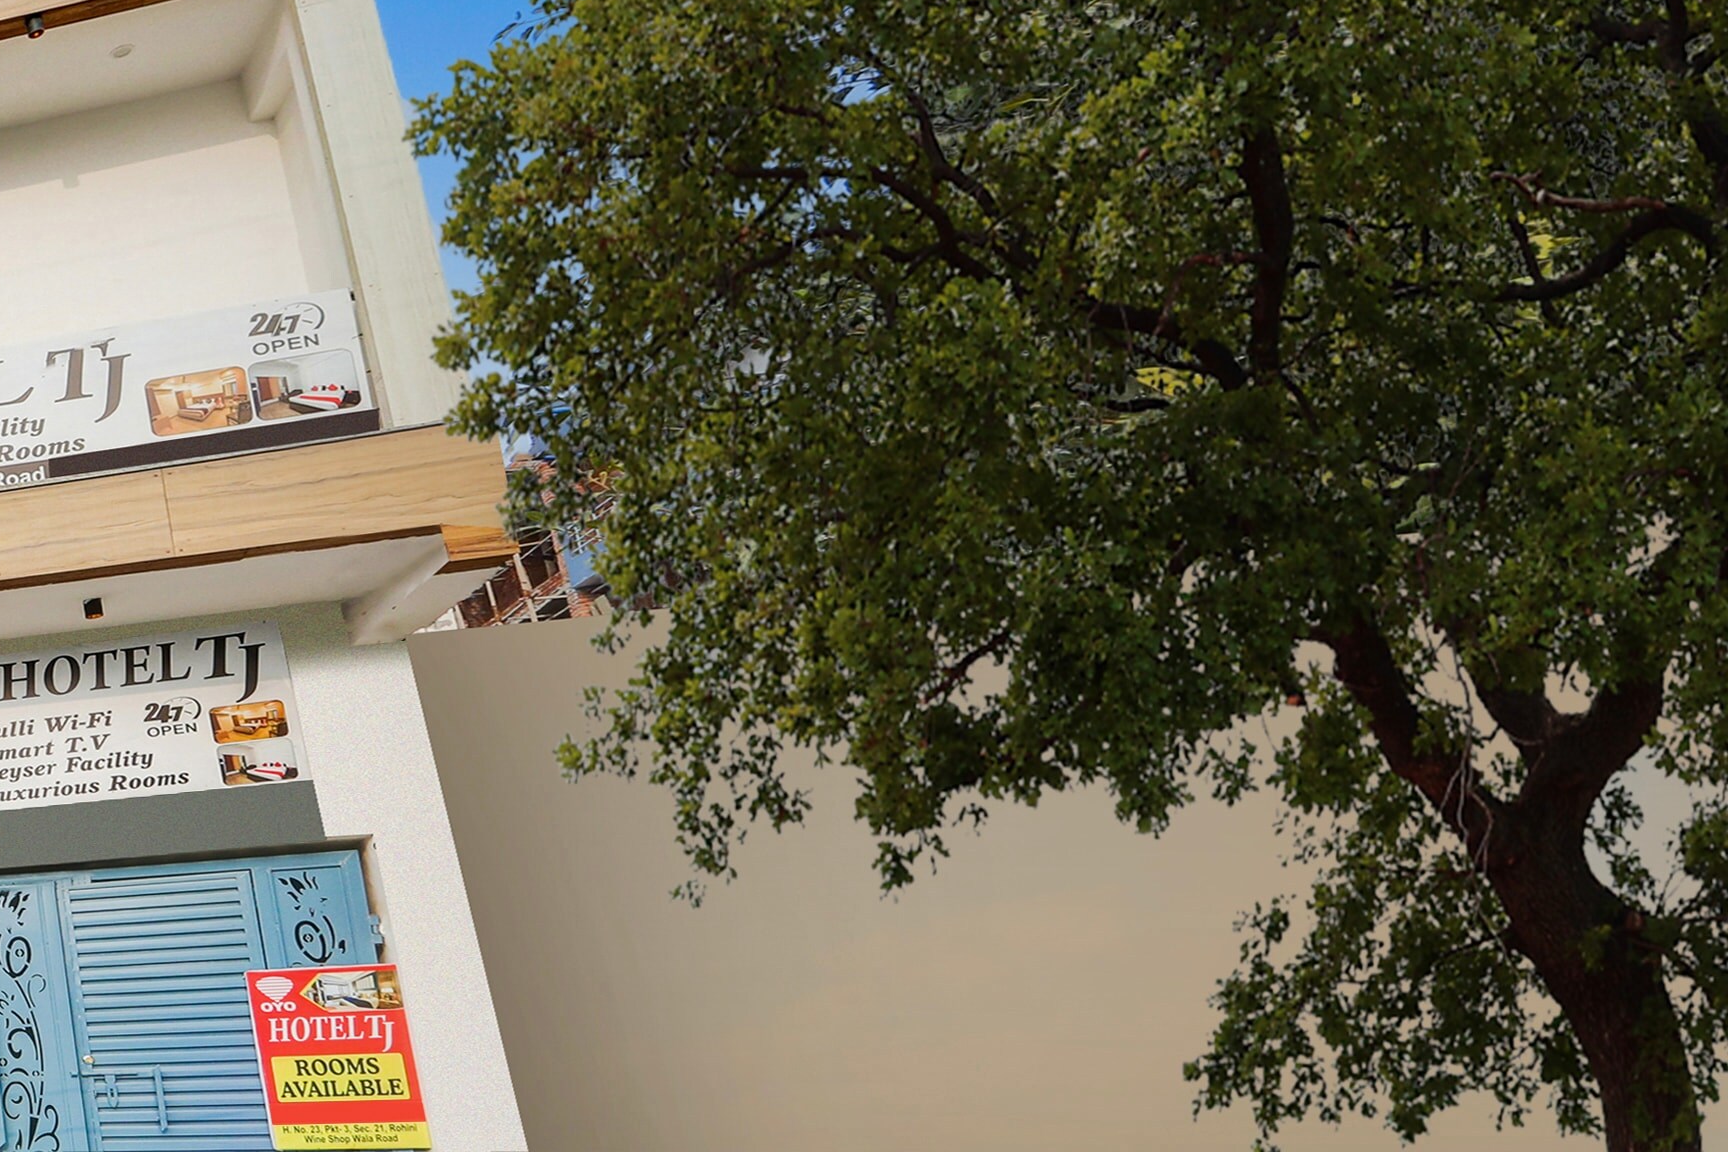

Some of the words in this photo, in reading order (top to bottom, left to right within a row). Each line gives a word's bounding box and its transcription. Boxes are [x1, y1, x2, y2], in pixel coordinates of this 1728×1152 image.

[252, 334, 320, 356] OPEN
[45, 338, 131, 424] TJ
[0, 641, 191, 702] HOTEL
[194, 631, 266, 703] TJ
[44, 710, 112, 734] Wi-Fi
[147, 722, 198, 738] OPEN
[64, 733, 111, 754] T.V
[63, 750, 154, 775] Facility
[108, 771, 190, 793] Rooms
[260, 1001, 297, 1013] OYO
[268, 1015, 364, 1042] HOTEL
[364, 1014, 395, 1052] TJ
[294, 1057, 380, 1076] ROOMS
[281, 1078, 404, 1098] AVAILABLE
[282, 1126, 290, 1134] H.
[293, 1126, 308, 1134] No.
[389, 1123, 417, 1132] Rohini
[305, 1135, 325, 1143] Wine
[329, 1135, 351, 1144] Shop
[352, 1134, 374, 1143] Wala
[375, 1134, 398, 1142] Road
